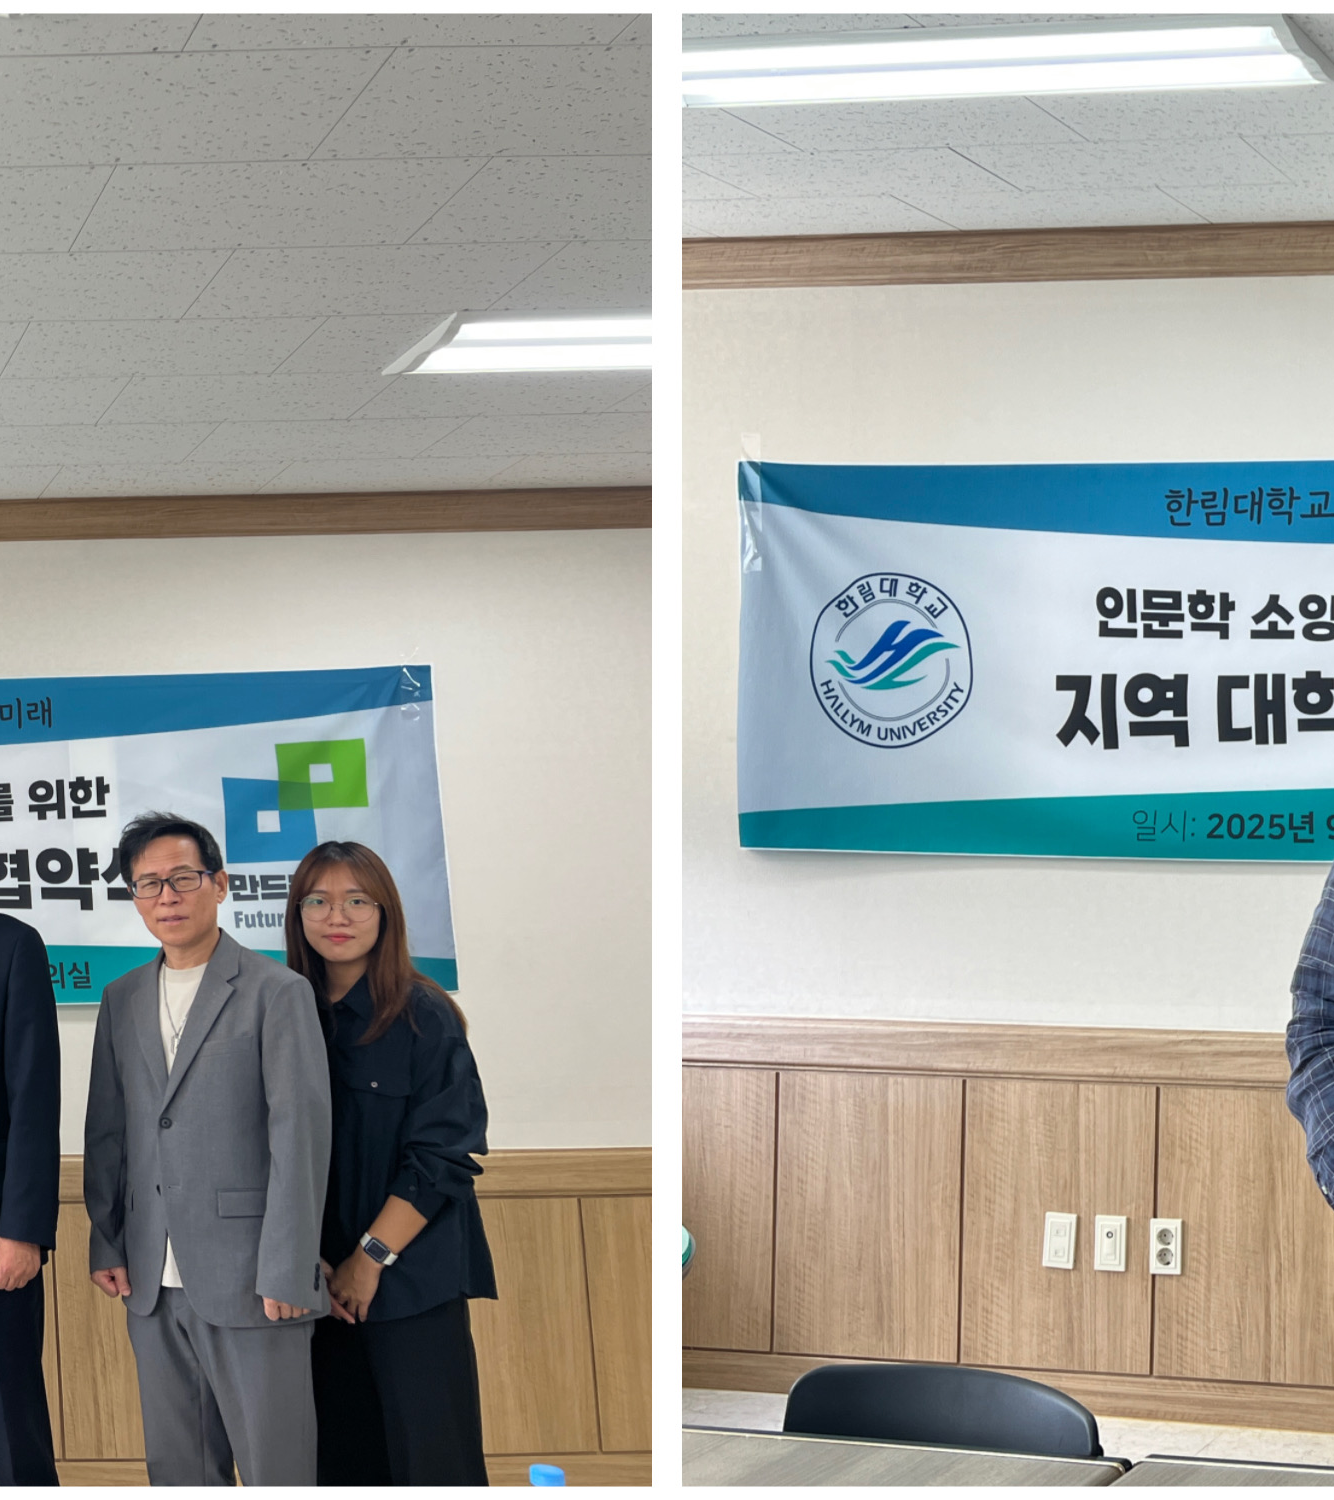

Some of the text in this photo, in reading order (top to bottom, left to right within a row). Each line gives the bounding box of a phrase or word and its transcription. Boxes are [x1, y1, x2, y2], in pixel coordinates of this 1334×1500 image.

[835, 577, 948, 619] 한림대학교
[1095, 586, 1235, 640] 인문학
[0, 697, 53, 729] 미래
[820, 679, 965, 741] HALLYM UNIVERSITY
[1055, 672, 1190, 750] 지역
[28, 776, 110, 821] 위한
[1132, 809, 1196, 842] 일시:
[1206, 811, 1315, 844] 2025년
[228, 874, 292, 902] 만드
[234, 910, 284, 929] Futur
[49, 961, 92, 989] 의실
